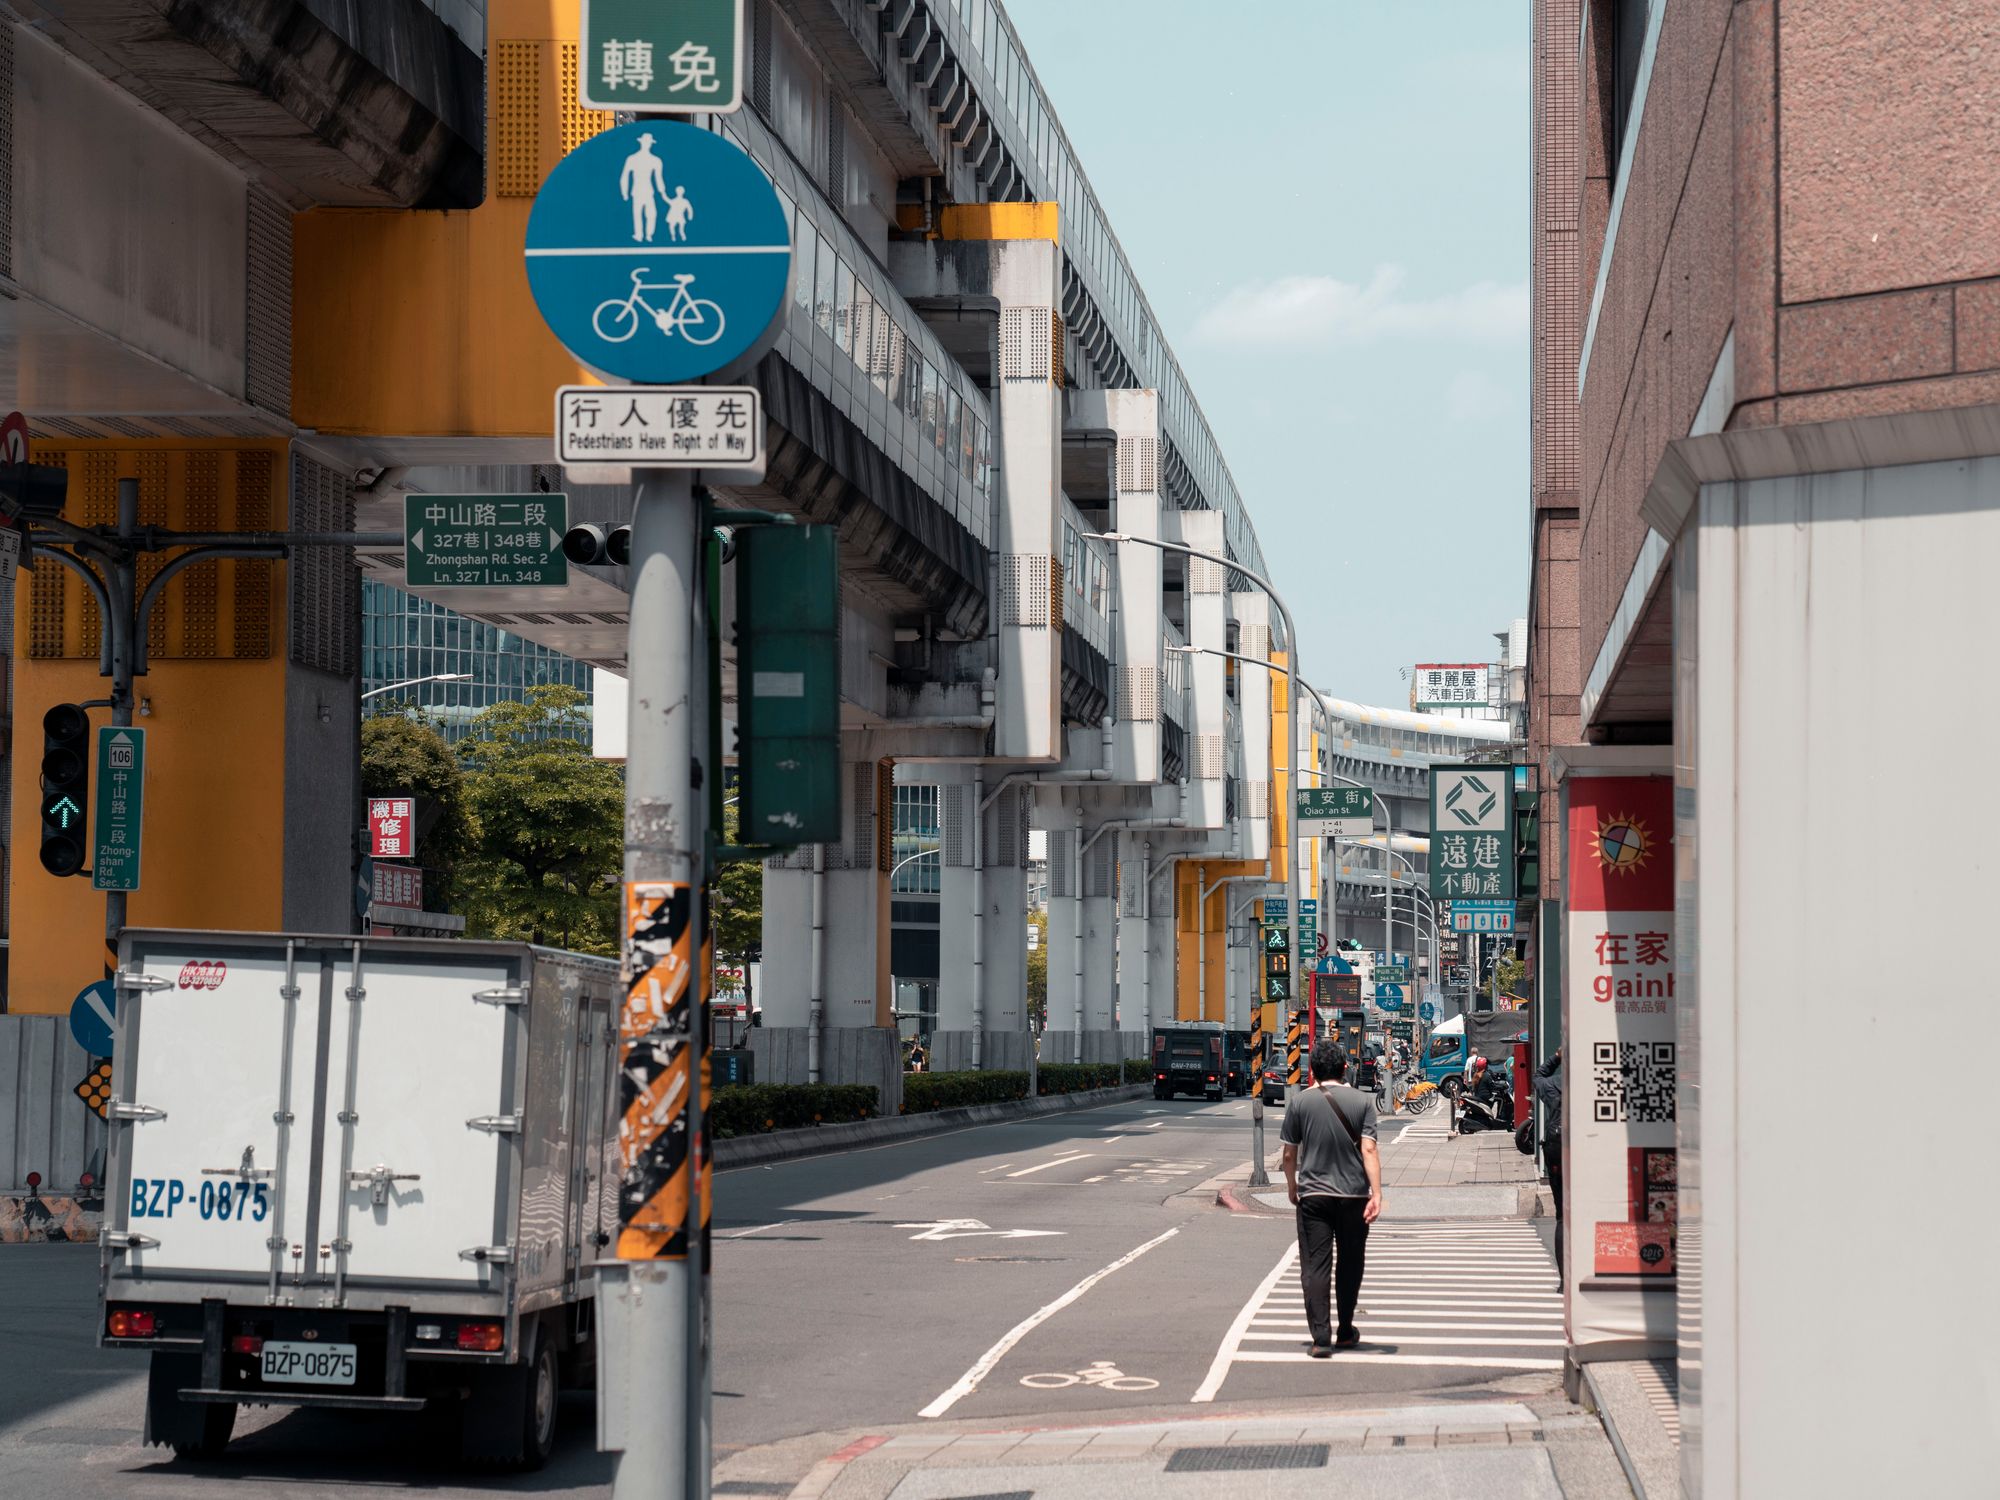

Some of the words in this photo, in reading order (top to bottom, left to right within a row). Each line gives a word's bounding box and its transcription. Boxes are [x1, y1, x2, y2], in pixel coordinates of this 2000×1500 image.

[570, 398, 747, 429] 行人優先
[569, 433, 633, 450] Pedestrians
[640, 433, 666, 450] Have
[673, 433, 701, 455] Right
[708, 433, 719, 450] of
[726, 433, 746, 454] Way
[425, 503, 547, 527] 中山路二段
[433, 532, 480, 548] 327巷
[494, 532, 542, 548] 348巷
[426, 553, 488, 568] Zhongshan
[492, 553, 510, 565] Rd.
[513, 553, 536, 565] Sec.
[539, 553, 548, 565] 2
[434, 571, 452, 583] Ln.
[456, 571, 480, 583] 327
[494, 571, 512, 583] Ln.
[516, 571, 542, 583] 348
[1428, 671, 1476, 687] 車麗屋
[1428, 688, 1477, 702] 汽車百貨
[112, 751, 131, 763] 106
[111, 770, 128, 844] 中山路二段
[372, 801, 409, 819] 機車
[100, 845, 135, 858] Zhong-
[1440, 834, 1501, 869] 遠建
[99, 856, 124, 866] shan
[99, 867, 115, 877] Rd.
[99, 877, 120, 887] Sec.
[124, 878, 131, 887] 2
[1440, 872, 1501, 895] 不動產
[1595, 931, 1670, 966] 在家
[1273, 954, 1286, 971] 17
[1615, 1000, 1667, 1014] 最高品質
[131, 1178, 268, 1222] BZP-0875
